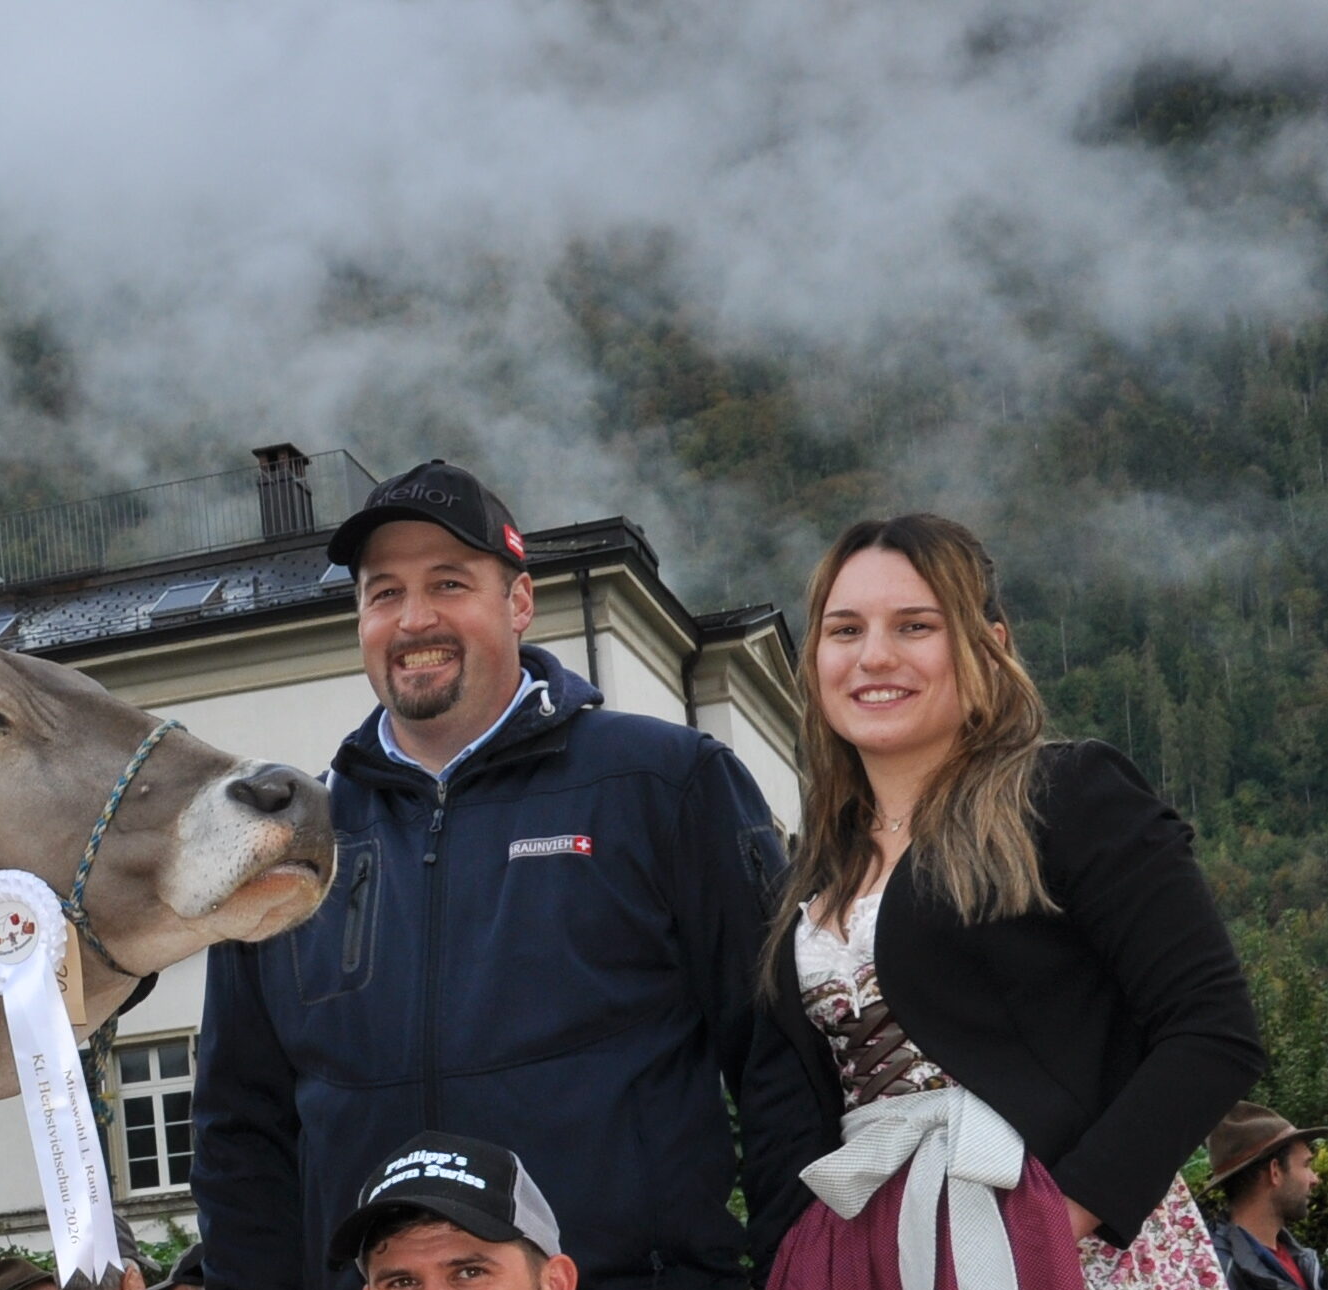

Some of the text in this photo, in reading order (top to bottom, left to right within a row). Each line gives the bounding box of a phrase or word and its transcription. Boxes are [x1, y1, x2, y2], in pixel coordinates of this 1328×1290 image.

[32, 1053, 80, 1245] Kt. Herbstviehschau 2026
[64, 1069, 87, 1142] Misswahl
[84, 1164, 99, 1205] Rang
[384, 1149, 467, 1176] Philipp's
[424, 1164, 486, 1189] Swiss
